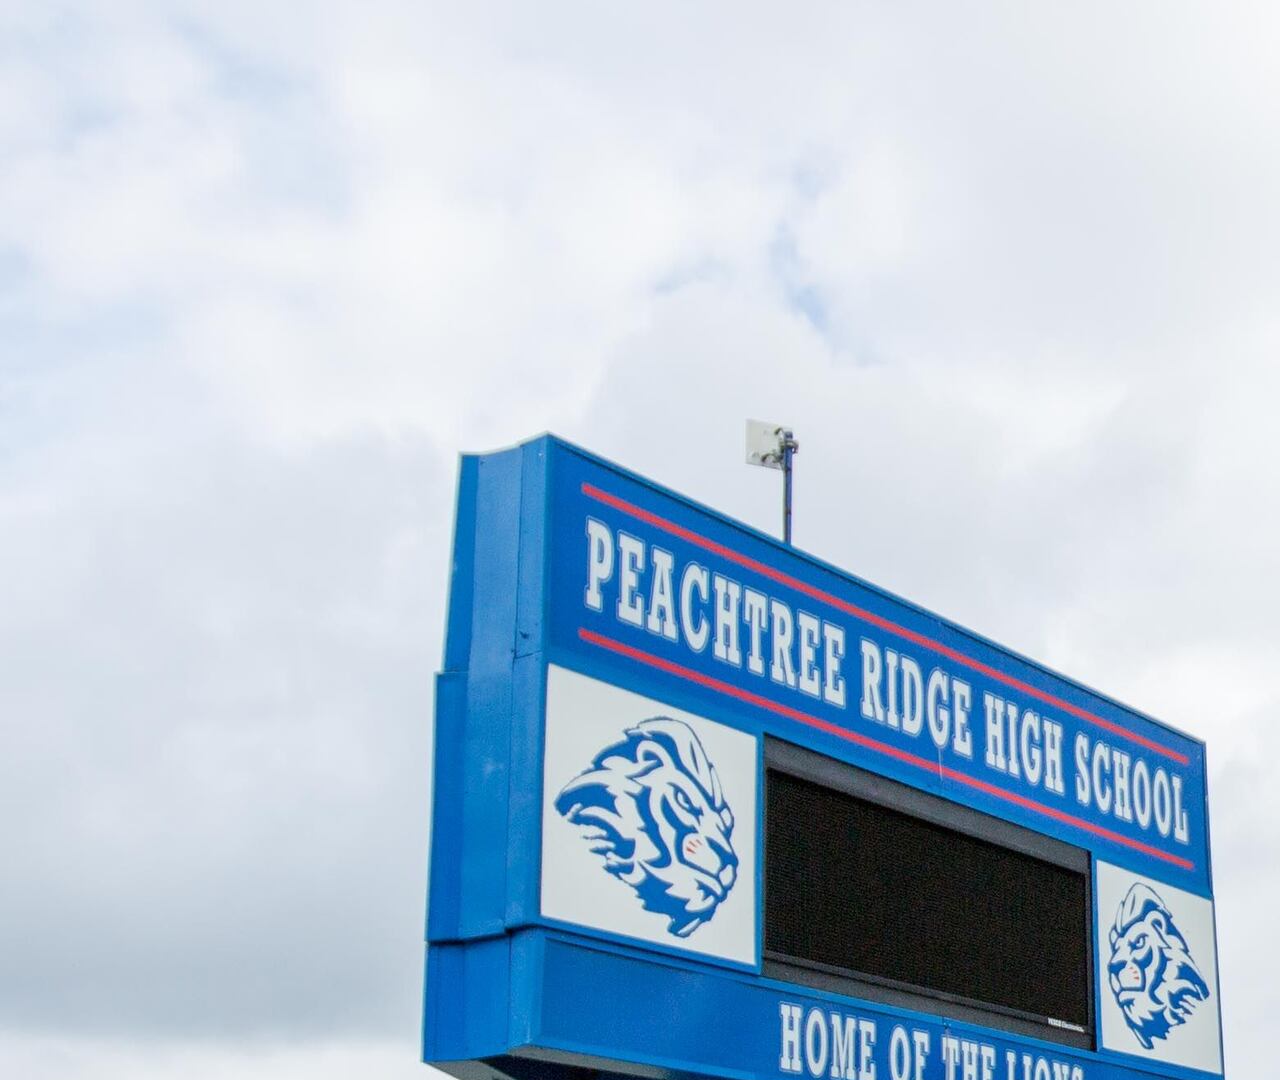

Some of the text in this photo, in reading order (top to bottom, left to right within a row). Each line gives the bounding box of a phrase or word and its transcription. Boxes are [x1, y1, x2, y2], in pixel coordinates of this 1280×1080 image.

[584, 515, 1190, 845] PEACHTREE RIDGE HIGH SCHOOL
